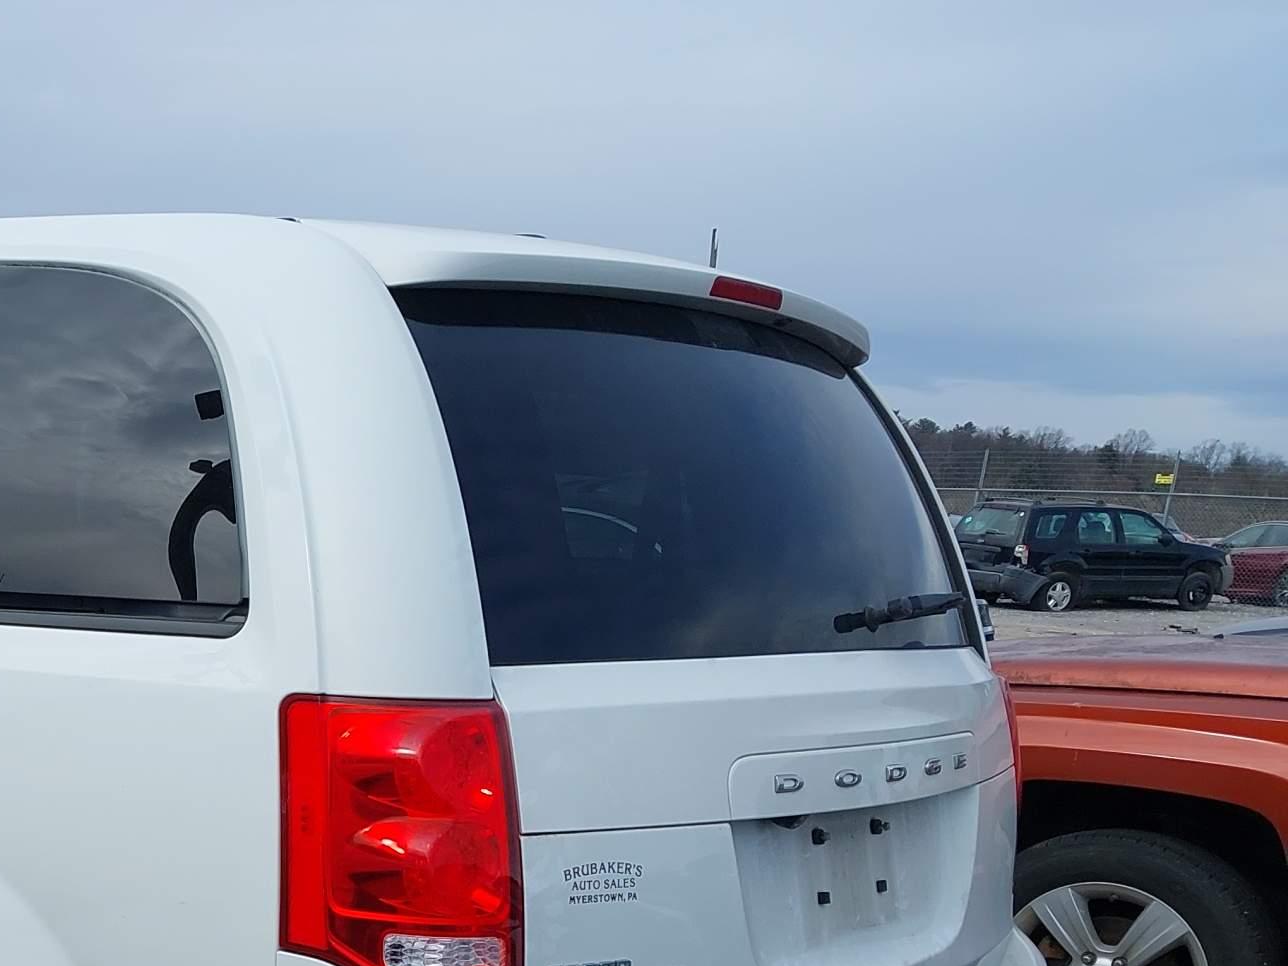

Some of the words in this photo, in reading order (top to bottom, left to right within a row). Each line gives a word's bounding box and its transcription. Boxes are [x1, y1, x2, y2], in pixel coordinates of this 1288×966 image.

[773, 752, 968, 794] DODGE
[563, 861, 643, 882] BRUBAKER'S
[572, 879, 601, 891] AUTO
[604, 877, 636, 890] SALES
[569, 893, 626, 905] MYERSTOWN,
[627, 891, 638, 901] PA
